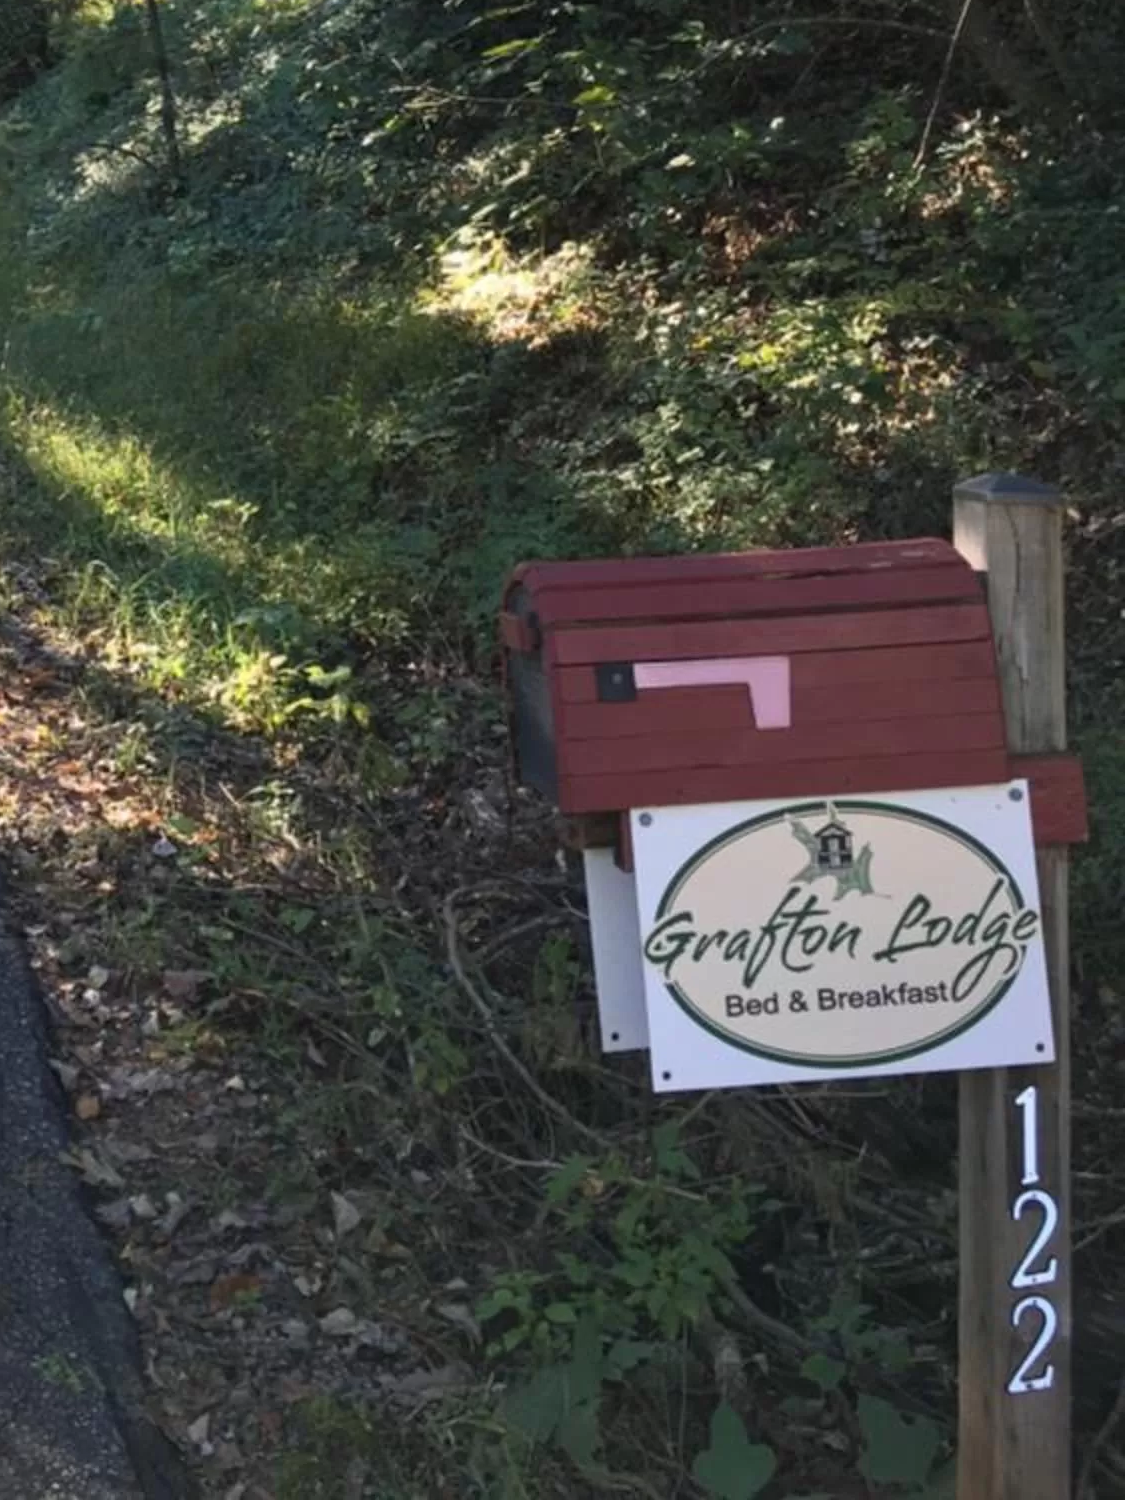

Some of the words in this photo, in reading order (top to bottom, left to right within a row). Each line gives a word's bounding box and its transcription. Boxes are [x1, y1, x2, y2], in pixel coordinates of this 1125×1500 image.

[644, 886, 863, 989] Grafton
[873, 878, 1038, 1001] Lodge
[725, 993, 779, 1018] Bed
[788, 990, 809, 1013] &
[818, 980, 949, 1012] Breakfast
[1007, 1085, 1058, 1393] 122
